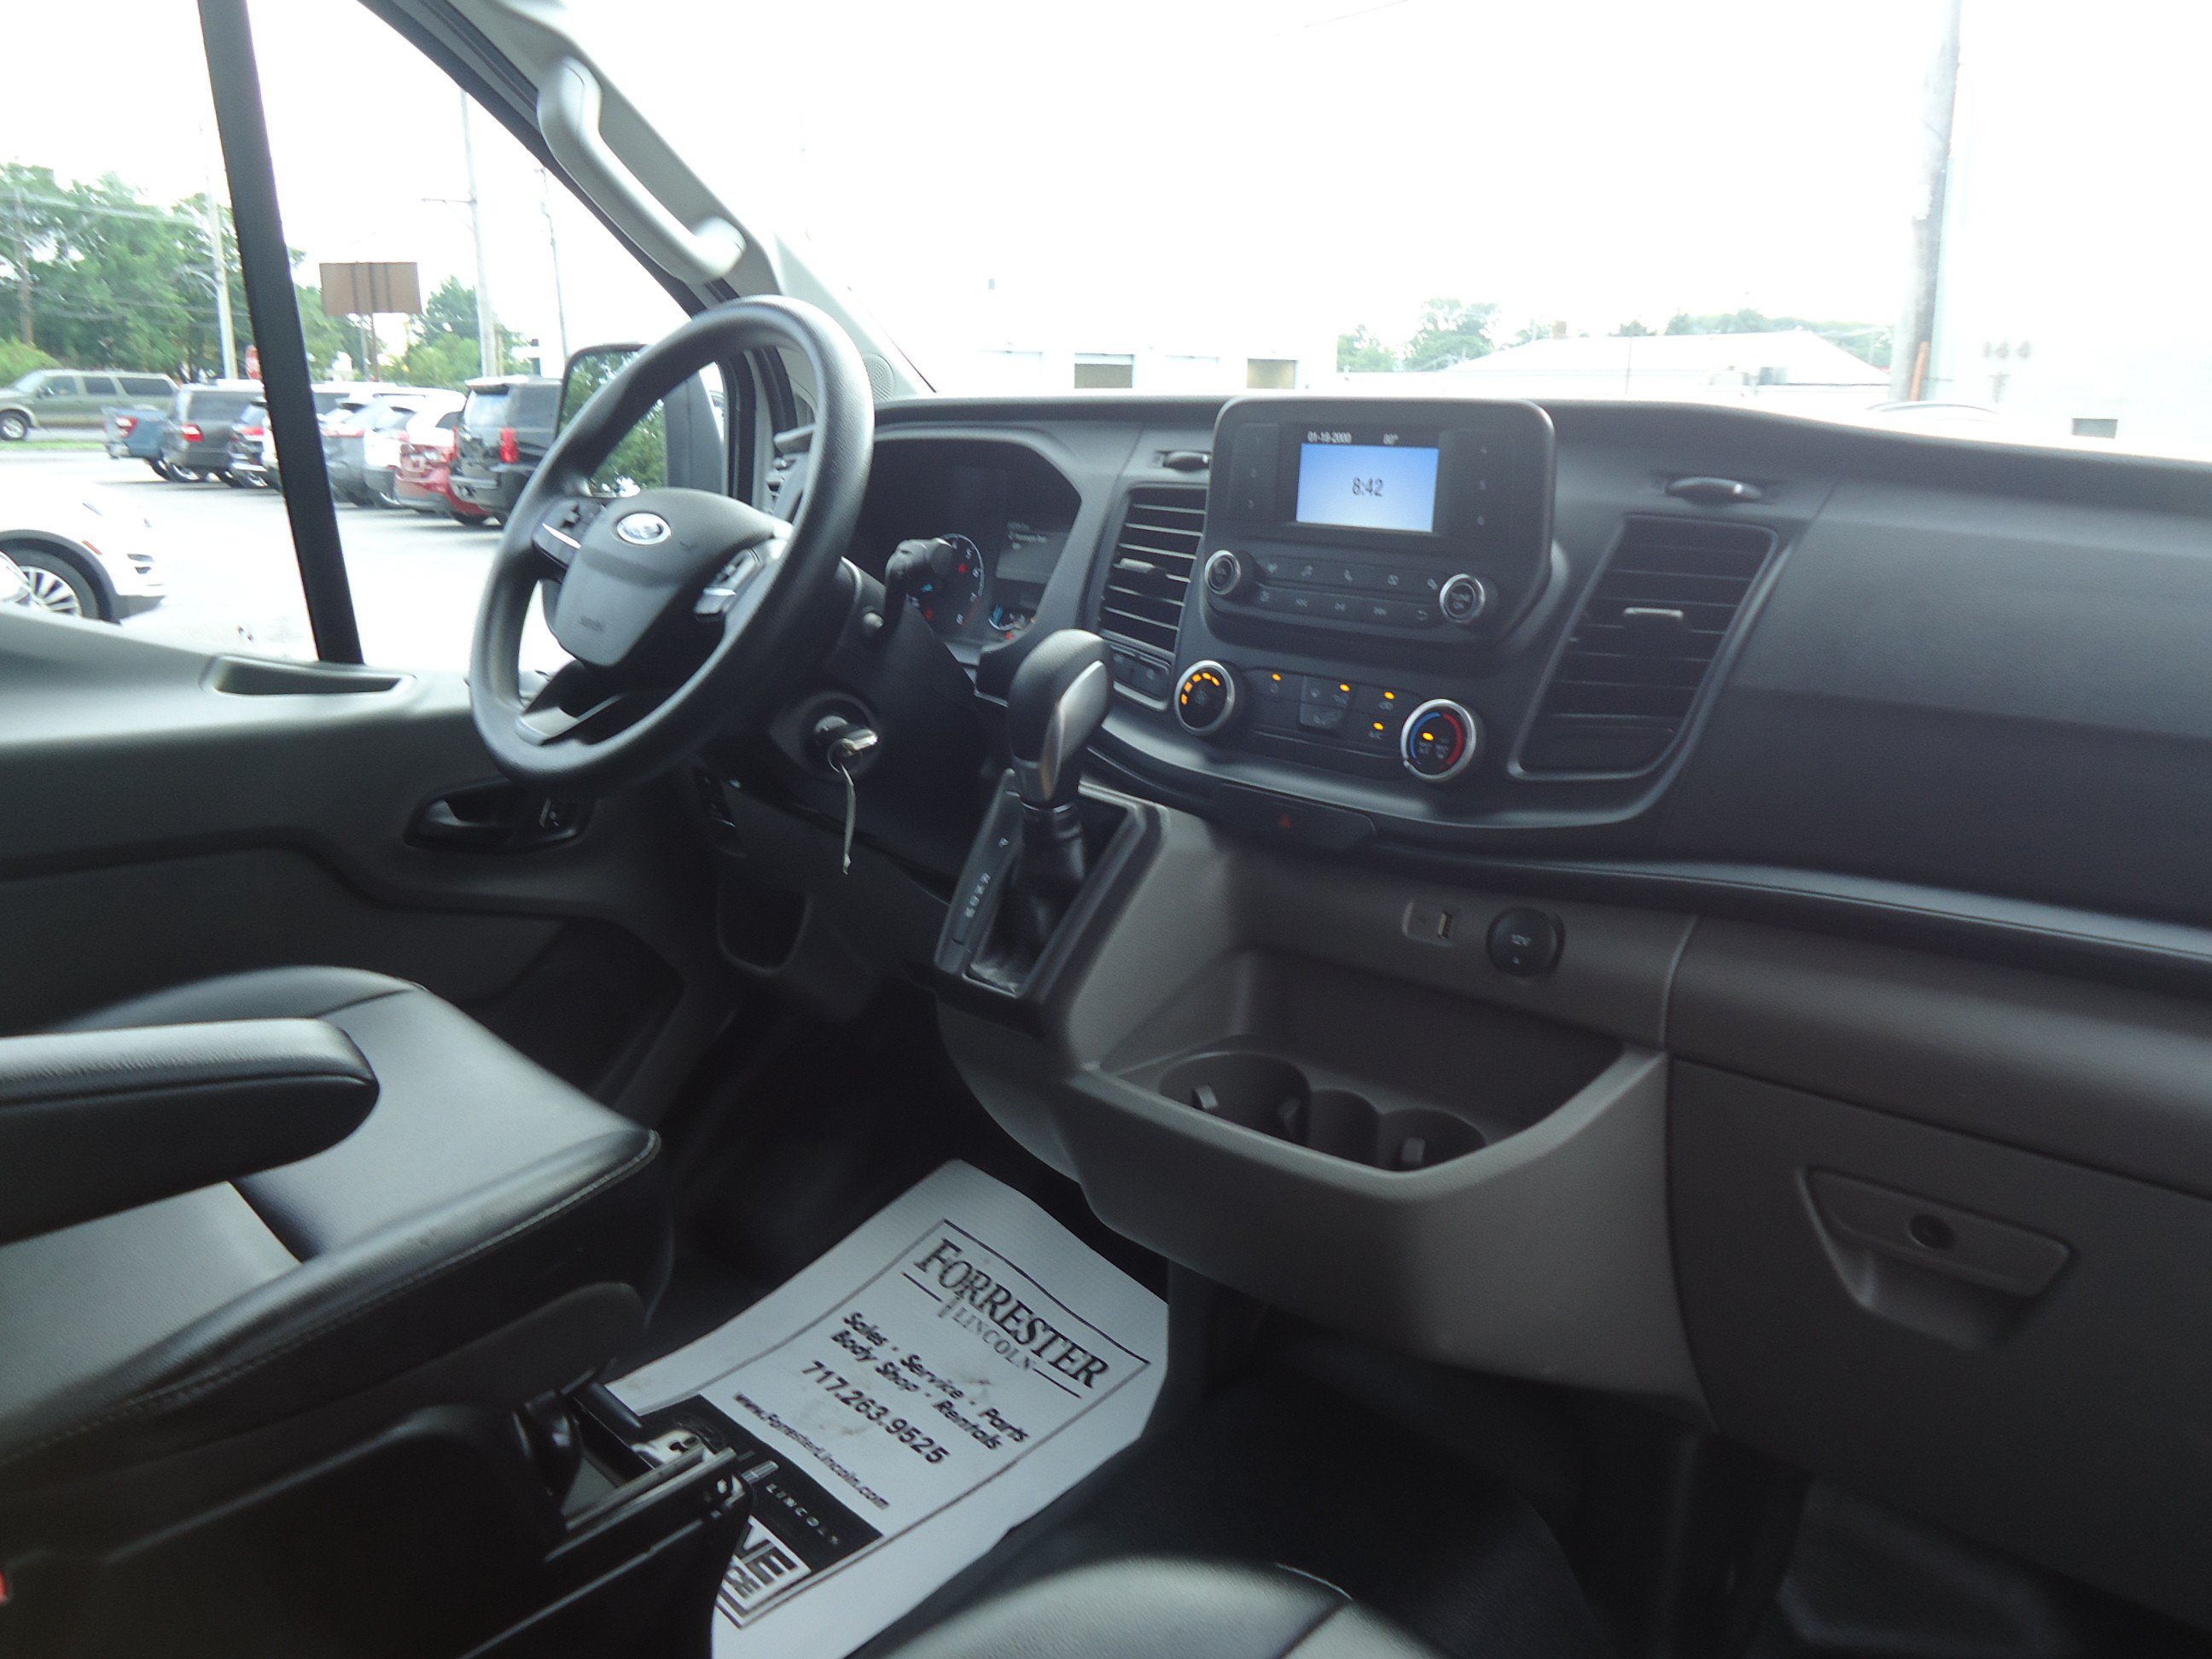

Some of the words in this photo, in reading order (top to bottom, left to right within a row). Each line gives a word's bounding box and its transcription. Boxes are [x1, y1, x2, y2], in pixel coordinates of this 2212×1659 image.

[1352, 477, 1383, 497] 8:42
[914, 1237, 1109, 1388] FORRESTER
[951, 1307, 1038, 1370] LINCOLN
[801, 1359, 951, 1464] 717.263.9525
[830, 1330, 878, 1362] Body
[876, 1361, 920, 1393] Shop
[932, 1400, 1002, 1450] Rentals
[843, 1312, 888, 1347] Sales
[900, 1354, 963, 1400] Service
[978, 1408, 1030, 1443] Parts
